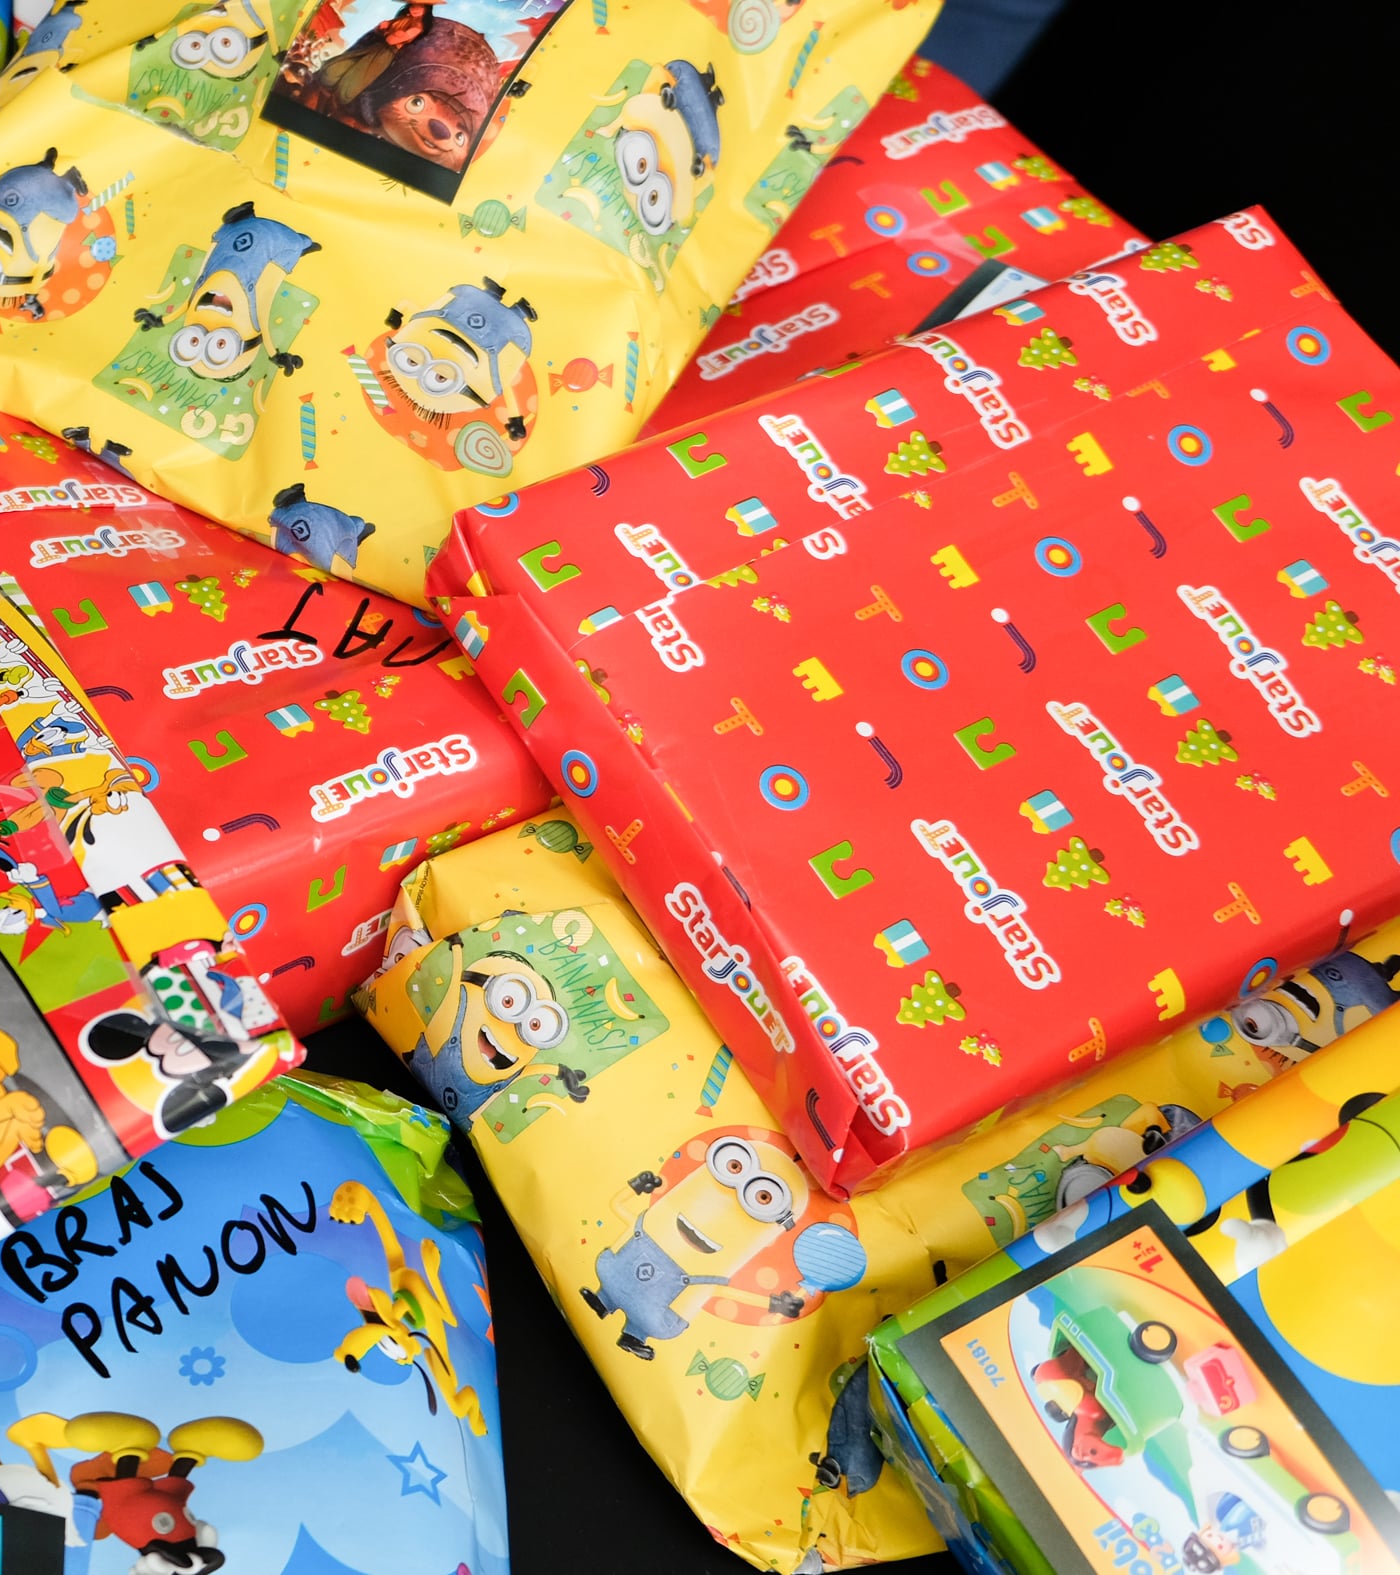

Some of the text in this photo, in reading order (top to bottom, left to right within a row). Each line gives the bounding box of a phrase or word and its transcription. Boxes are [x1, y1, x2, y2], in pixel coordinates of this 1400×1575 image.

[181, 410, 255, 445] GO
[538, 934, 628, 1052] BANANAS!
[61, 1181, 317, 1379] PANON
[965, 1338, 1005, 1388] 70181
